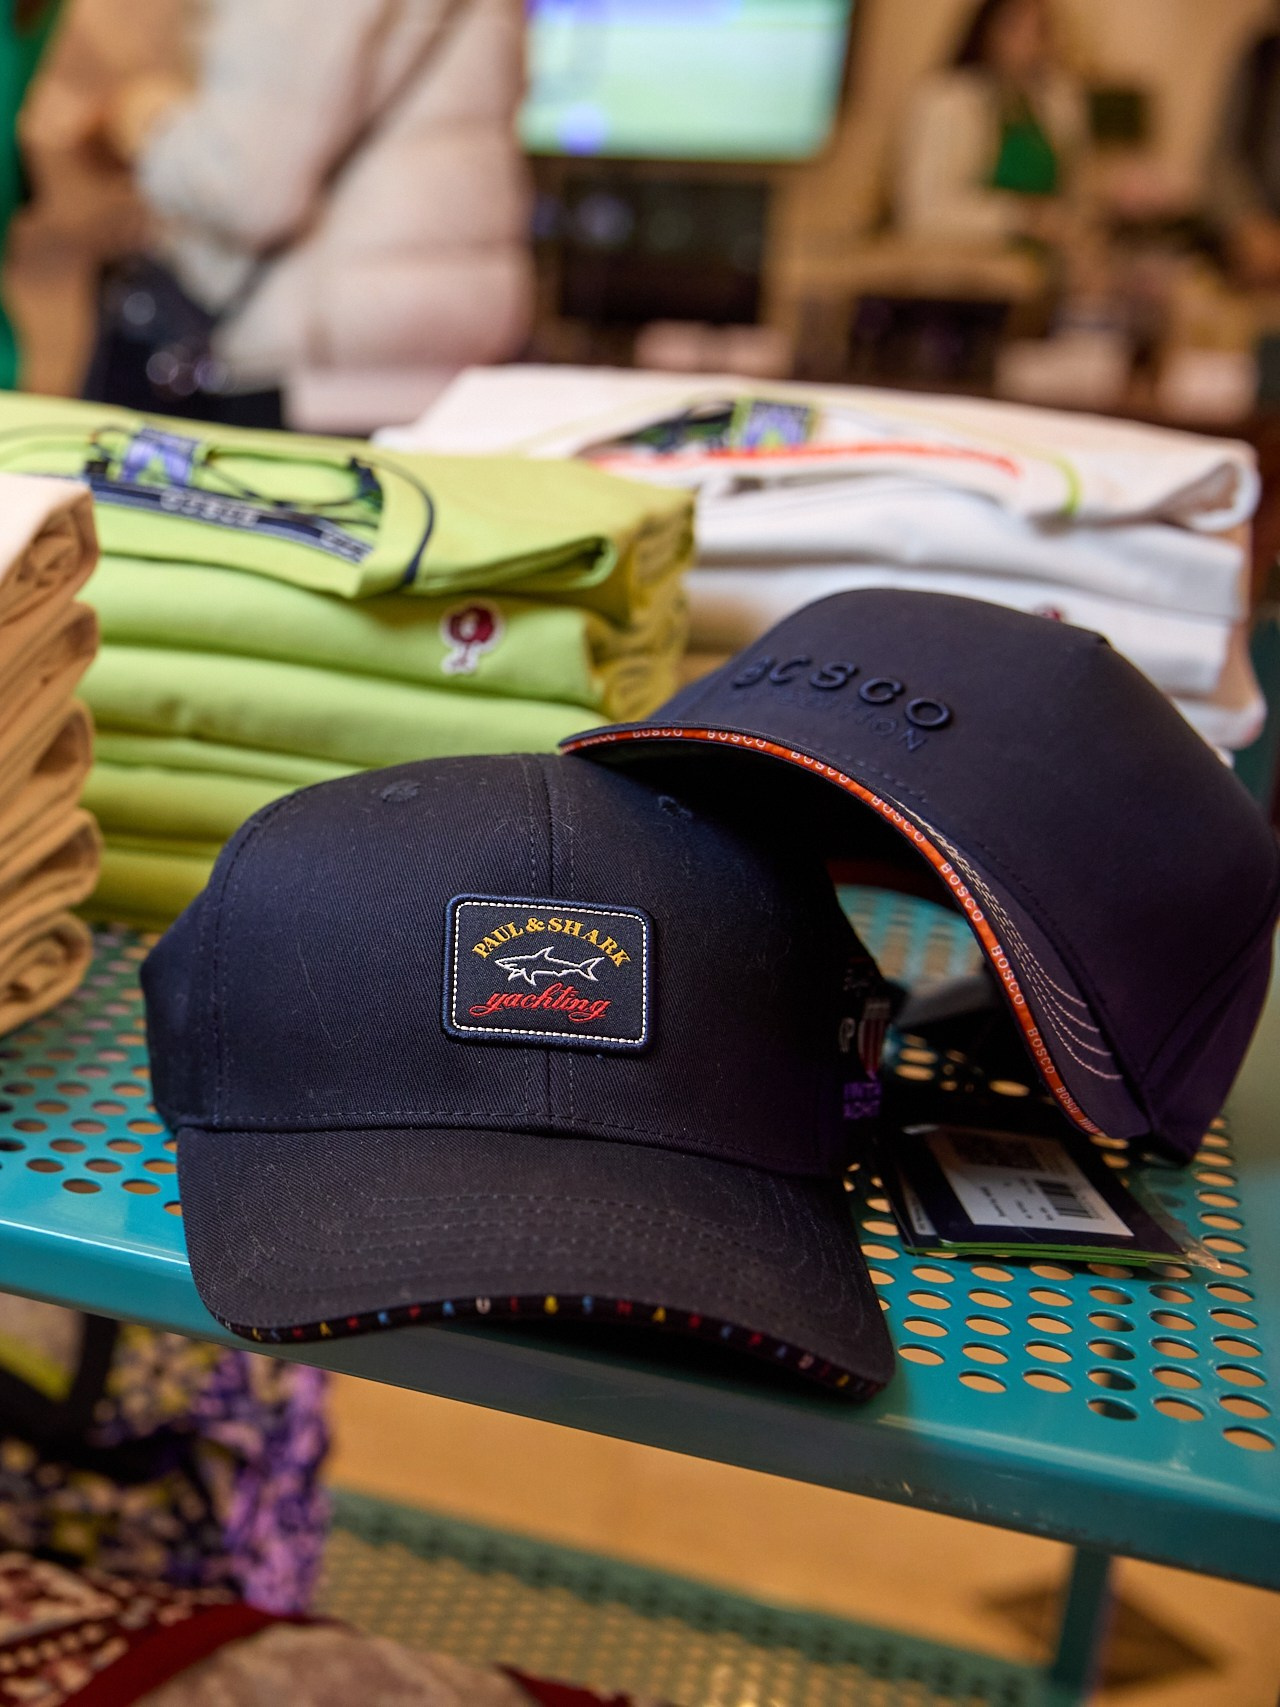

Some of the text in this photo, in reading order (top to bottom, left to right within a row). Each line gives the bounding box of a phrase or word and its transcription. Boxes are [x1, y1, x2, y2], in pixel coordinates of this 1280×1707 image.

[706, 730, 767, 748] BOSCO
[790, 750, 850, 783] BOSCO
[871, 795, 926, 843] BOSCO
[939, 862, 984, 922] BOSCO
[991, 944, 1025, 1006] BOSCO
[1027, 1027, 1056, 1075] BOSCO
[472, 917, 632, 968] PAUL & SHARK
[469, 982, 613, 1023] yachting
